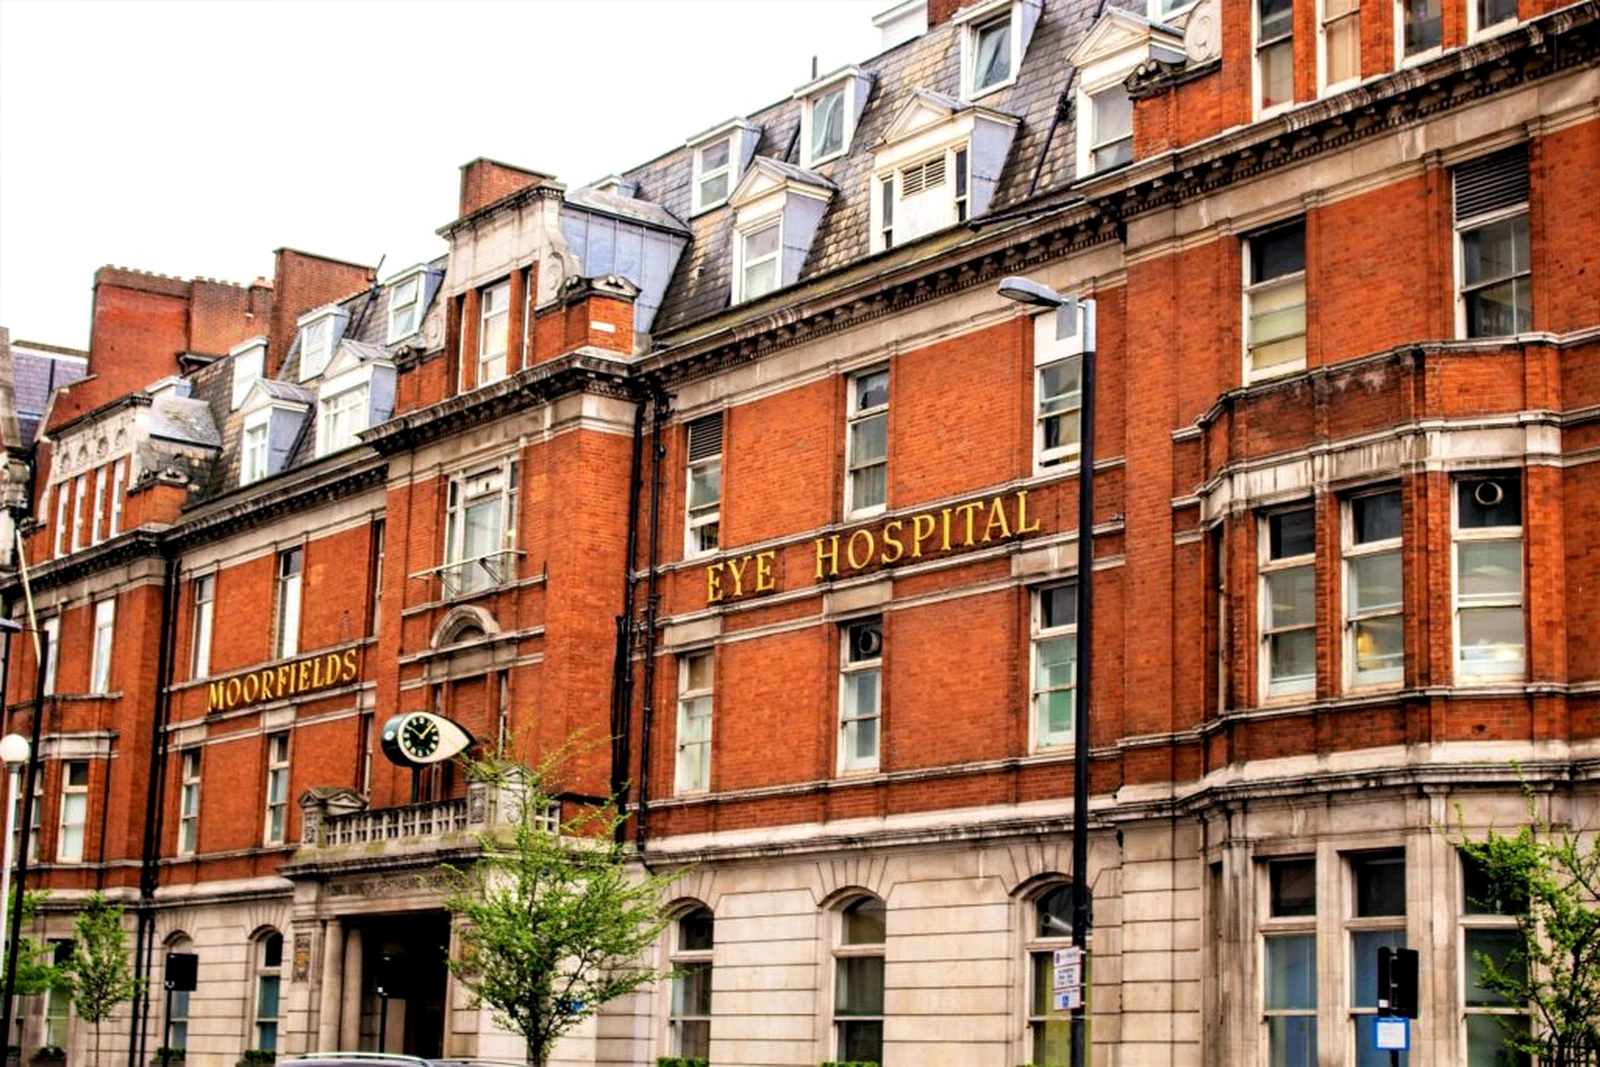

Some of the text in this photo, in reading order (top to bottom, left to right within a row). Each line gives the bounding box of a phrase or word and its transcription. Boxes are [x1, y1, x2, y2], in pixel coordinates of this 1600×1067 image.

[707, 490, 1041, 602] EYE HOSPITAL
[207, 649, 357, 713] MOORFIELDS
